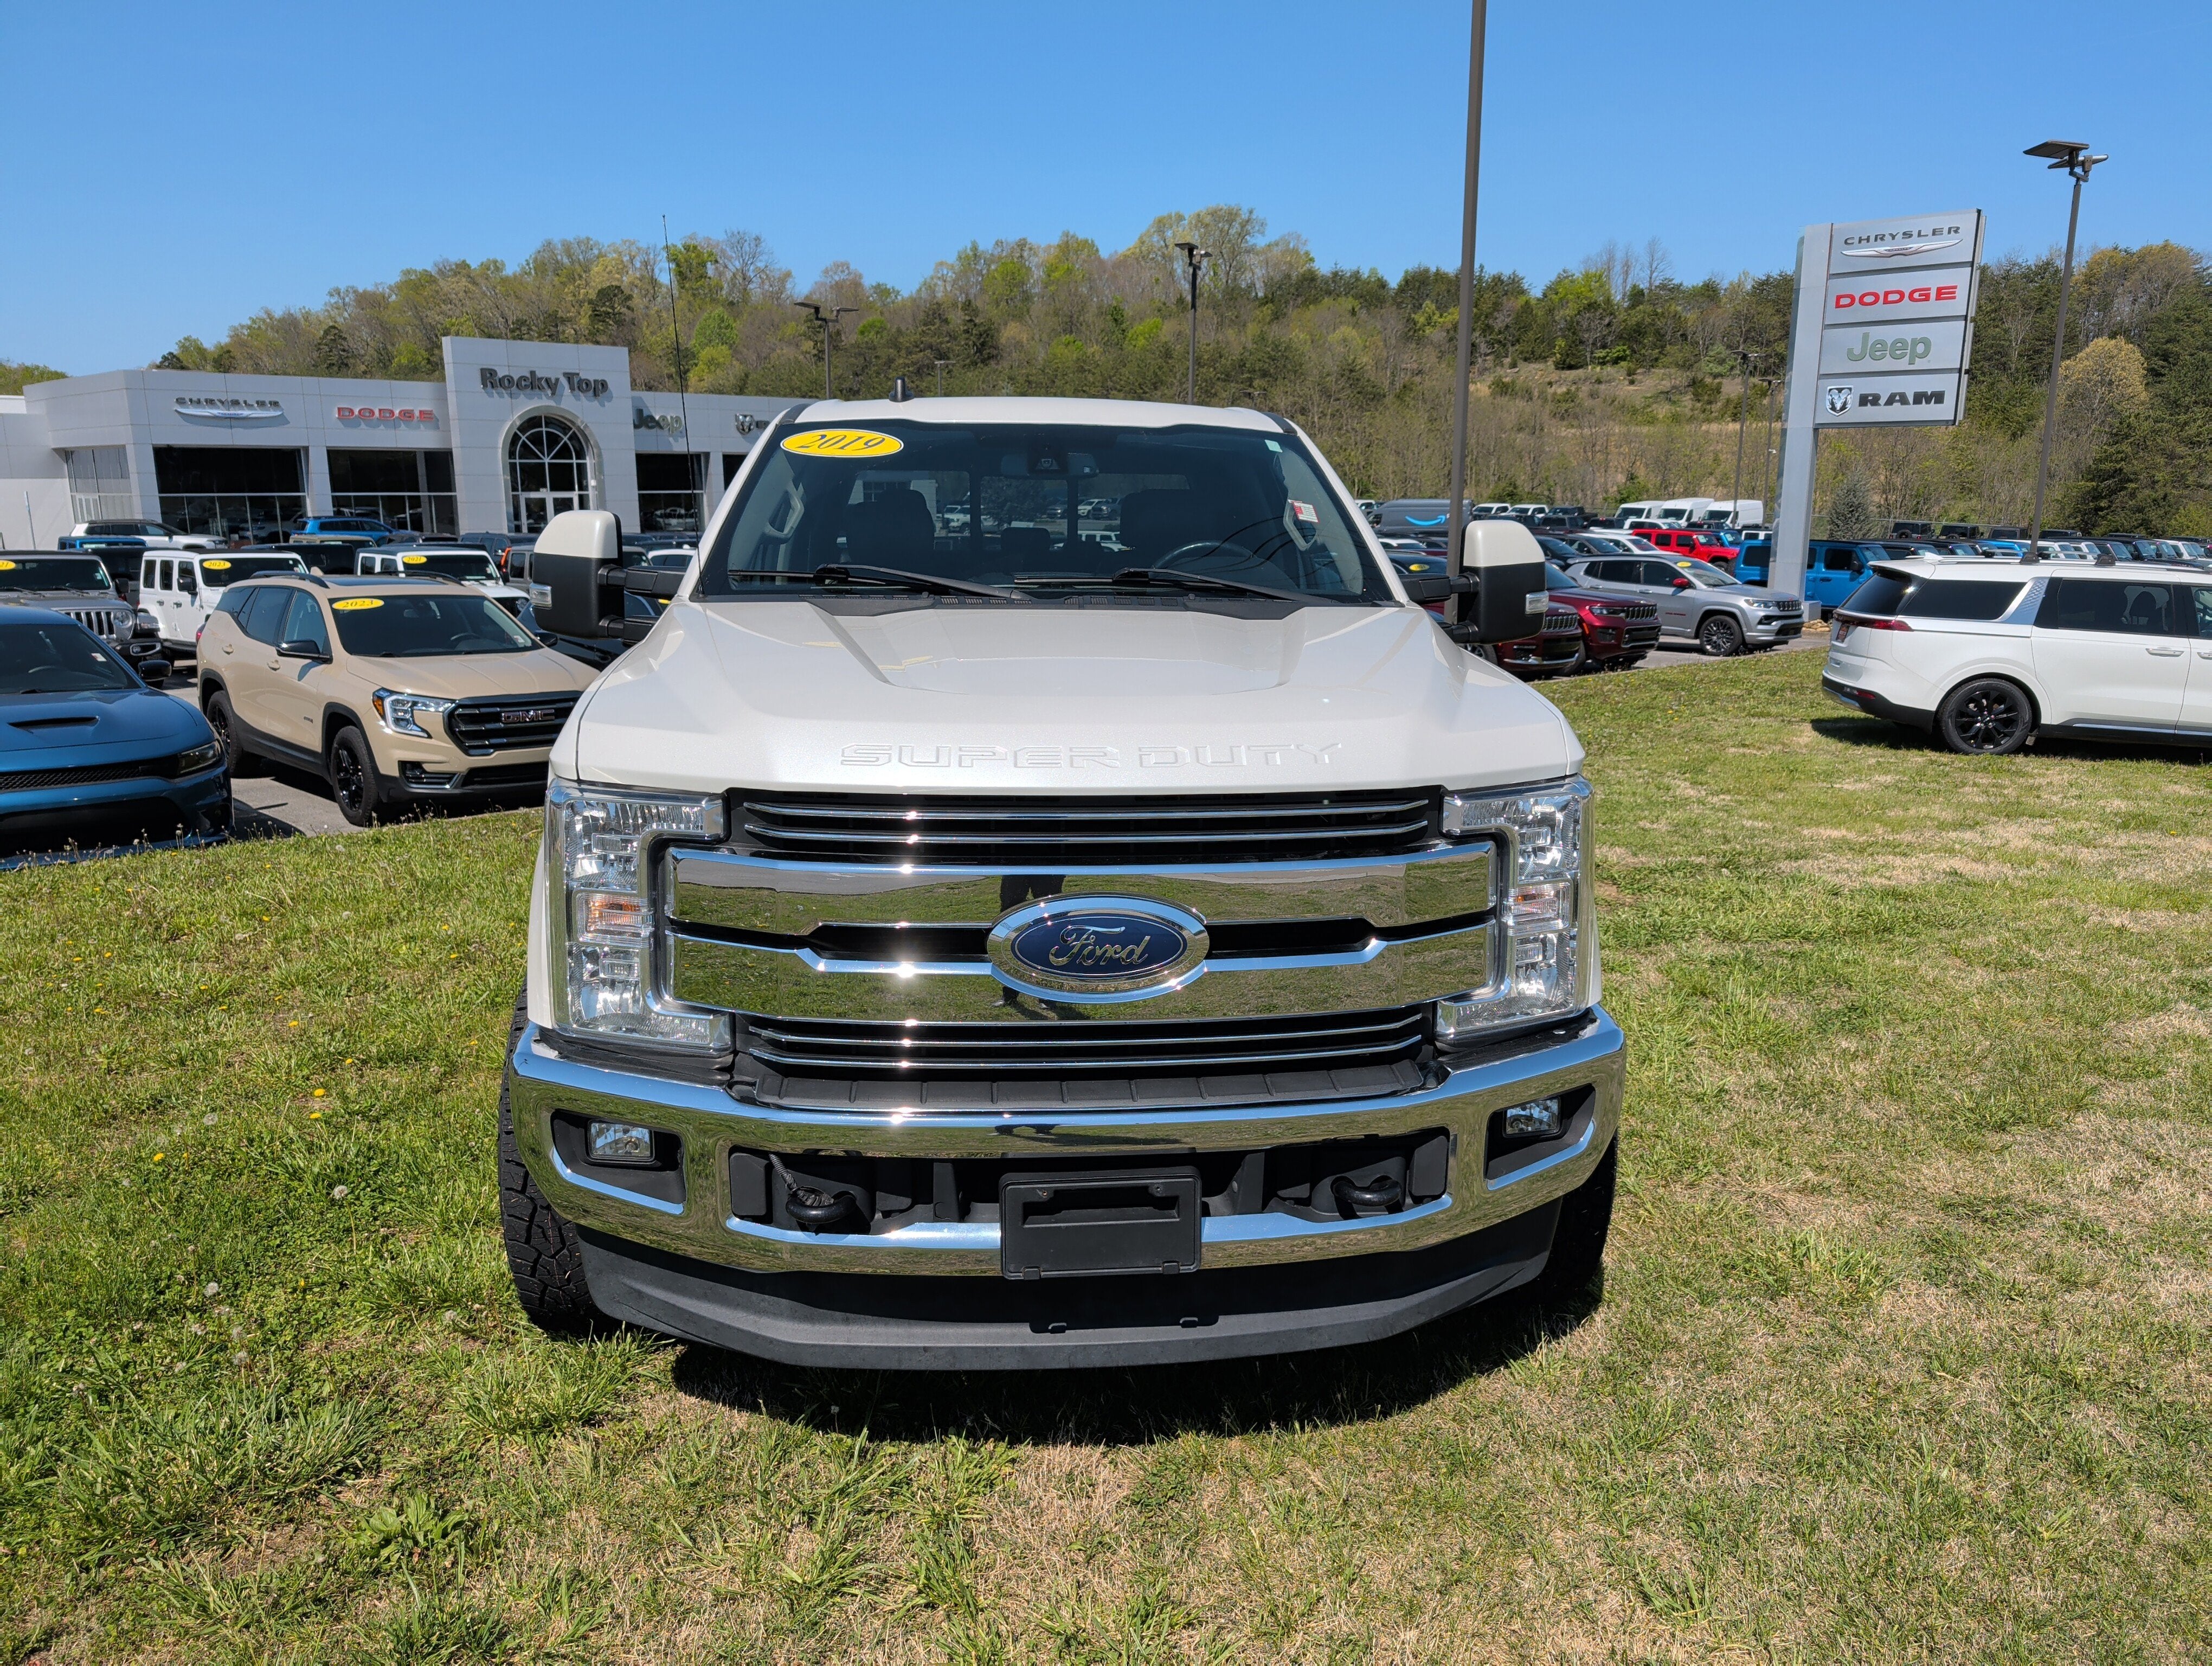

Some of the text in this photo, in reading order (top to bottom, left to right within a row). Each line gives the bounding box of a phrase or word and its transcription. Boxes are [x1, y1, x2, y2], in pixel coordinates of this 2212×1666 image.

[1844, 226, 1960, 246] CHRYSLER
[1835, 285, 1958, 309] DODGE
[1847, 332, 1932, 365] Jeep
[480, 368, 608, 398] Rocky Top
[175, 396, 280, 407] CHRYSLER
[1859, 390, 1946, 407] RAM
[337, 407, 434, 421] DODGE
[633, 408, 683, 434] Jeep
[796, 434, 885, 451] 2019
[501, 708, 555, 723] GMC
[840, 742, 1342, 768] SUPER DUTY
[1049, 925, 1151, 966] Ford
